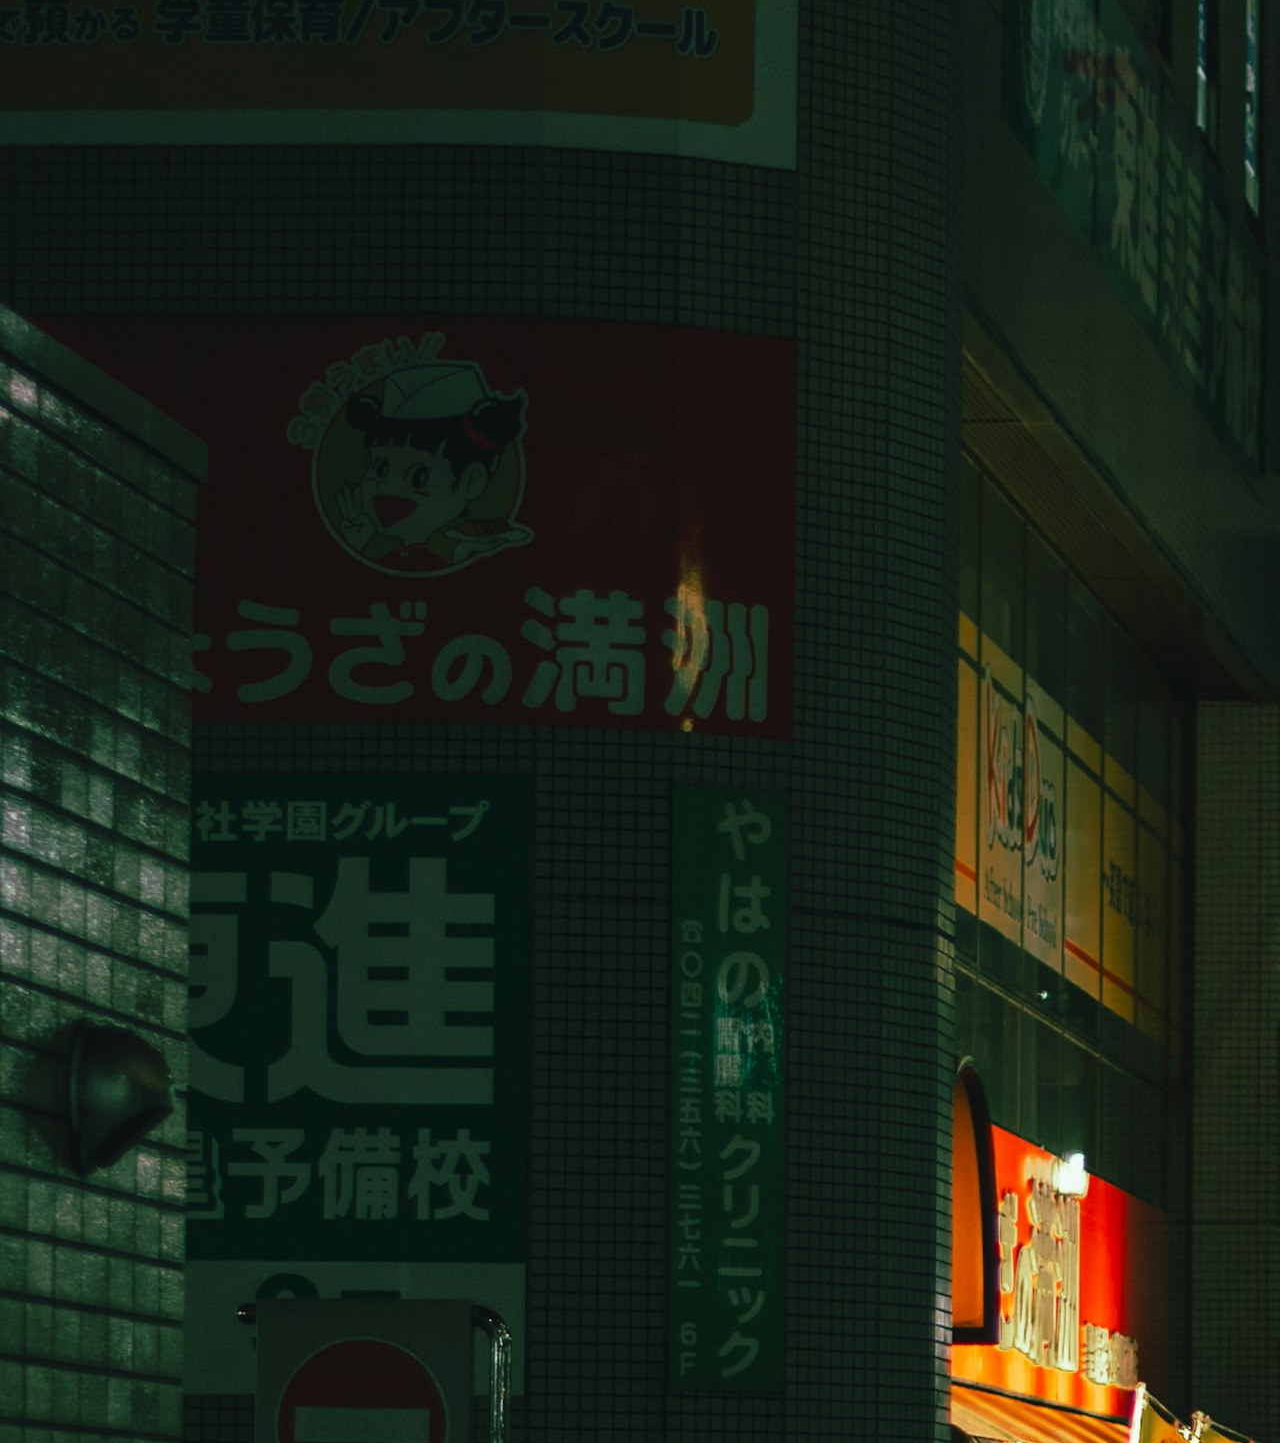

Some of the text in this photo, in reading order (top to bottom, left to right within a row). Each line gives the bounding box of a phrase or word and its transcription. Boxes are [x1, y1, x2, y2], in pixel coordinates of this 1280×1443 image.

[717, 798, 772, 1008] やはの
[187, 1123, 493, 1222] 予備校
[718, 1134, 766, 1379] クリニック
